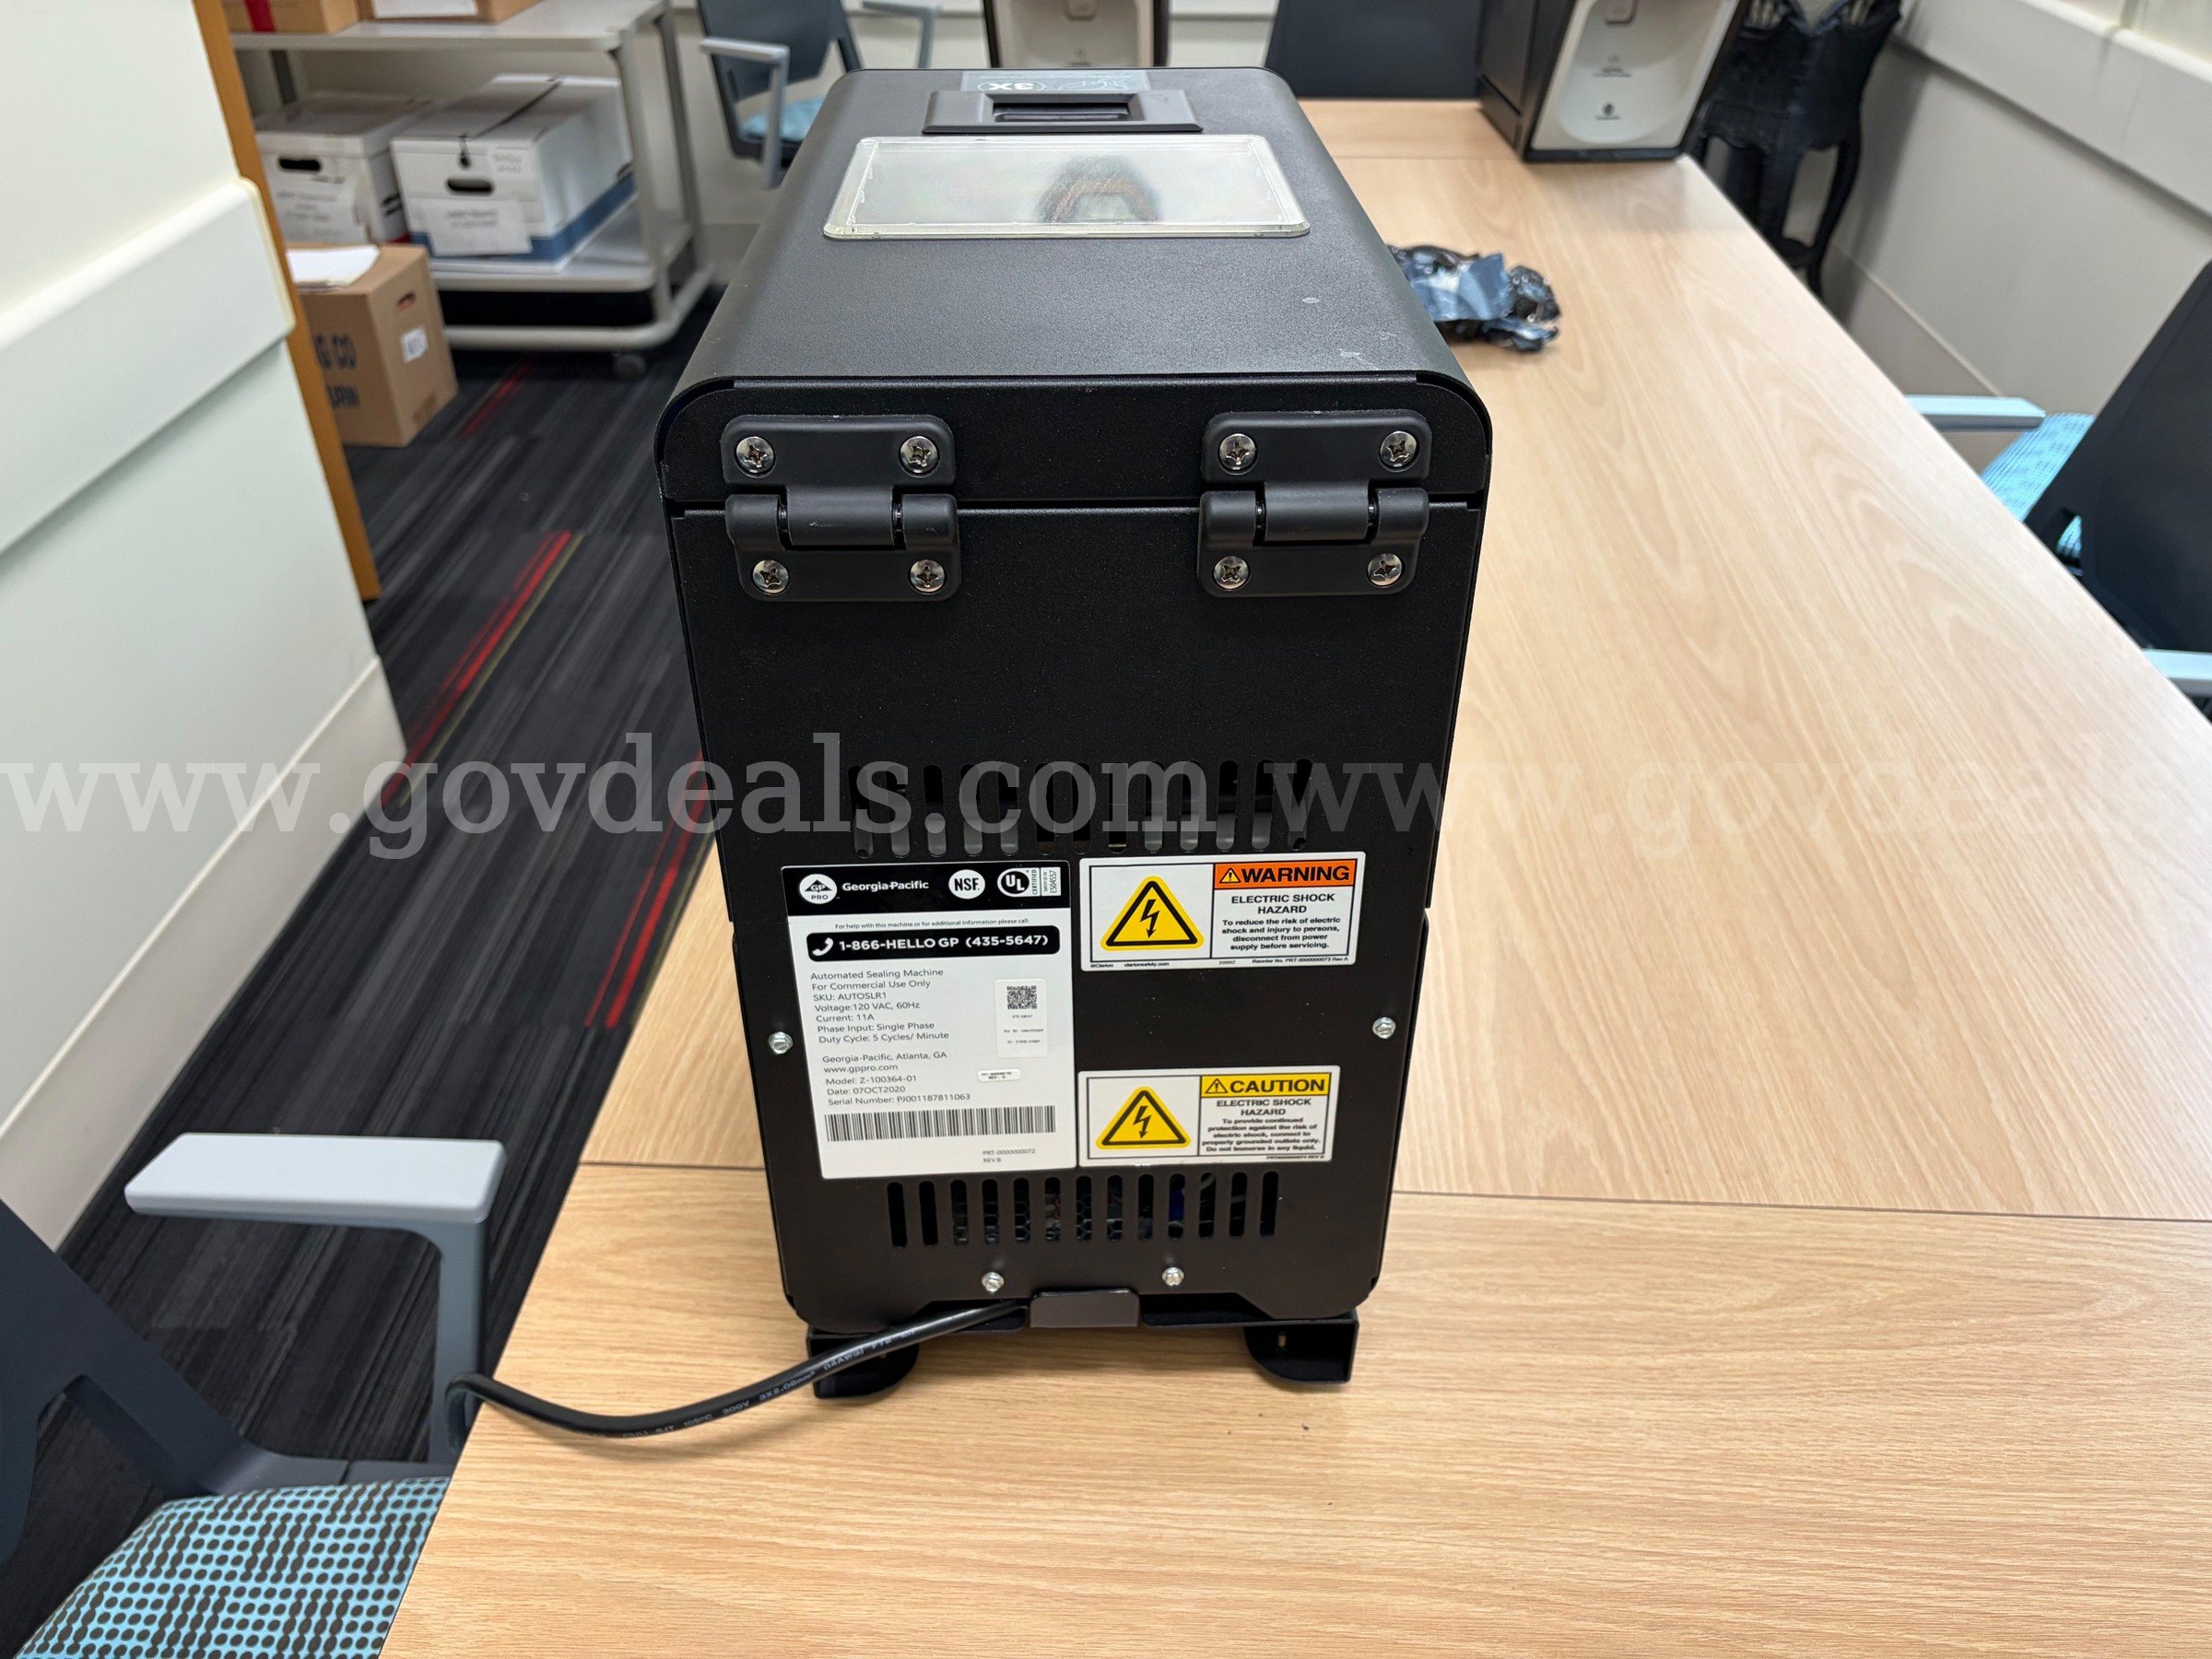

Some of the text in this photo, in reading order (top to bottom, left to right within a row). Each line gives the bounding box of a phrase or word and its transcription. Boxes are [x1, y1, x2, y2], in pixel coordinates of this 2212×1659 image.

[1241, 865, 1349, 883] WARNING
[842, 879, 929, 892] Georgia-Pacific
[953, 877, 979, 892] NSF
[1005, 874, 1025, 892] UL
[1231, 893, 1335, 904] ELECTRIC SHOCK
[1257, 905, 1307, 914] HAZARD
[1266, 925, 1290, 935] injury
[1303, 925, 1340, 934] persons,
[965, 935, 1049, 947] (435-5647)
[1288, 942, 1329, 950] servicing.
[810, 969, 944, 981] Automated Sealing Machine
[811, 982, 828, 992] For
[830, 981, 887, 991] Commercial
[908, 979, 931, 989] Only
[813, 992, 887, 1002] SKU: AUTOSLR1
[896, 1001, 920, 1009] 60Hz
[816, 1014, 853, 1023] Current:
[817, 1021, 935, 1034] Phase Input: Single Phase
[818, 1035, 841, 1045] Duty
[843, 1034, 870, 1043] Cycle:
[881, 1032, 914, 1043] Cycles/
[822, 1053, 894, 1064] Georgia-Pacific,
[933, 1051, 947, 1059] GA
[824, 1064, 899, 1075] www.gppro.com
[826, 1075, 917, 1086] Model: Z-100364-01
[1230, 1078, 1325, 1094] CAUTION
[853, 1085, 905, 1095] 07OCT2020
[829, 1098, 853, 1106] Serial
[1217, 1098, 1312, 1107] ELECTRIC SHOCK
[1241, 1108, 1287, 1116] HAZARD
